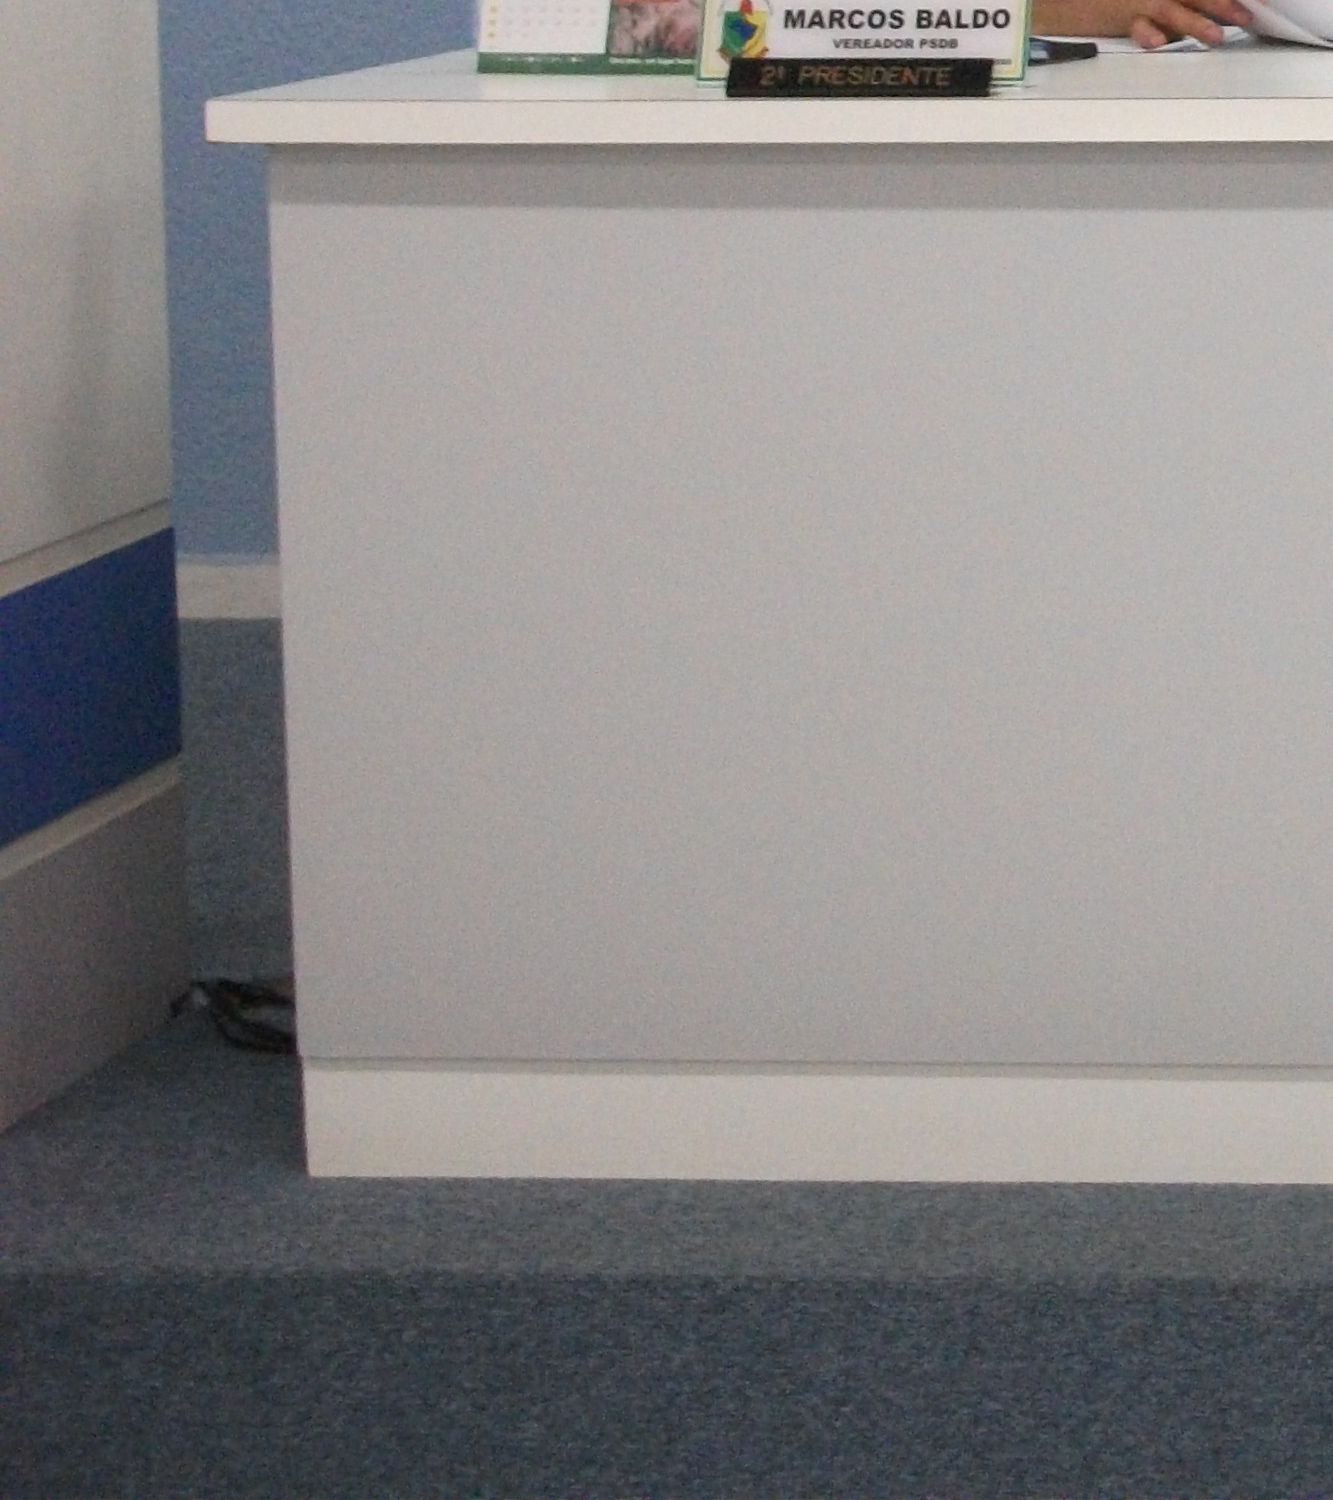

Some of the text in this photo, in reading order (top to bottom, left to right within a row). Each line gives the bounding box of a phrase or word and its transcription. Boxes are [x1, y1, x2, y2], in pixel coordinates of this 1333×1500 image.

[783, 8, 1011, 30] MARCOS BALDO
[832, 37, 959, 50] VEREADOR PSDB
[797, 64, 953, 86] PRESIDENTE
